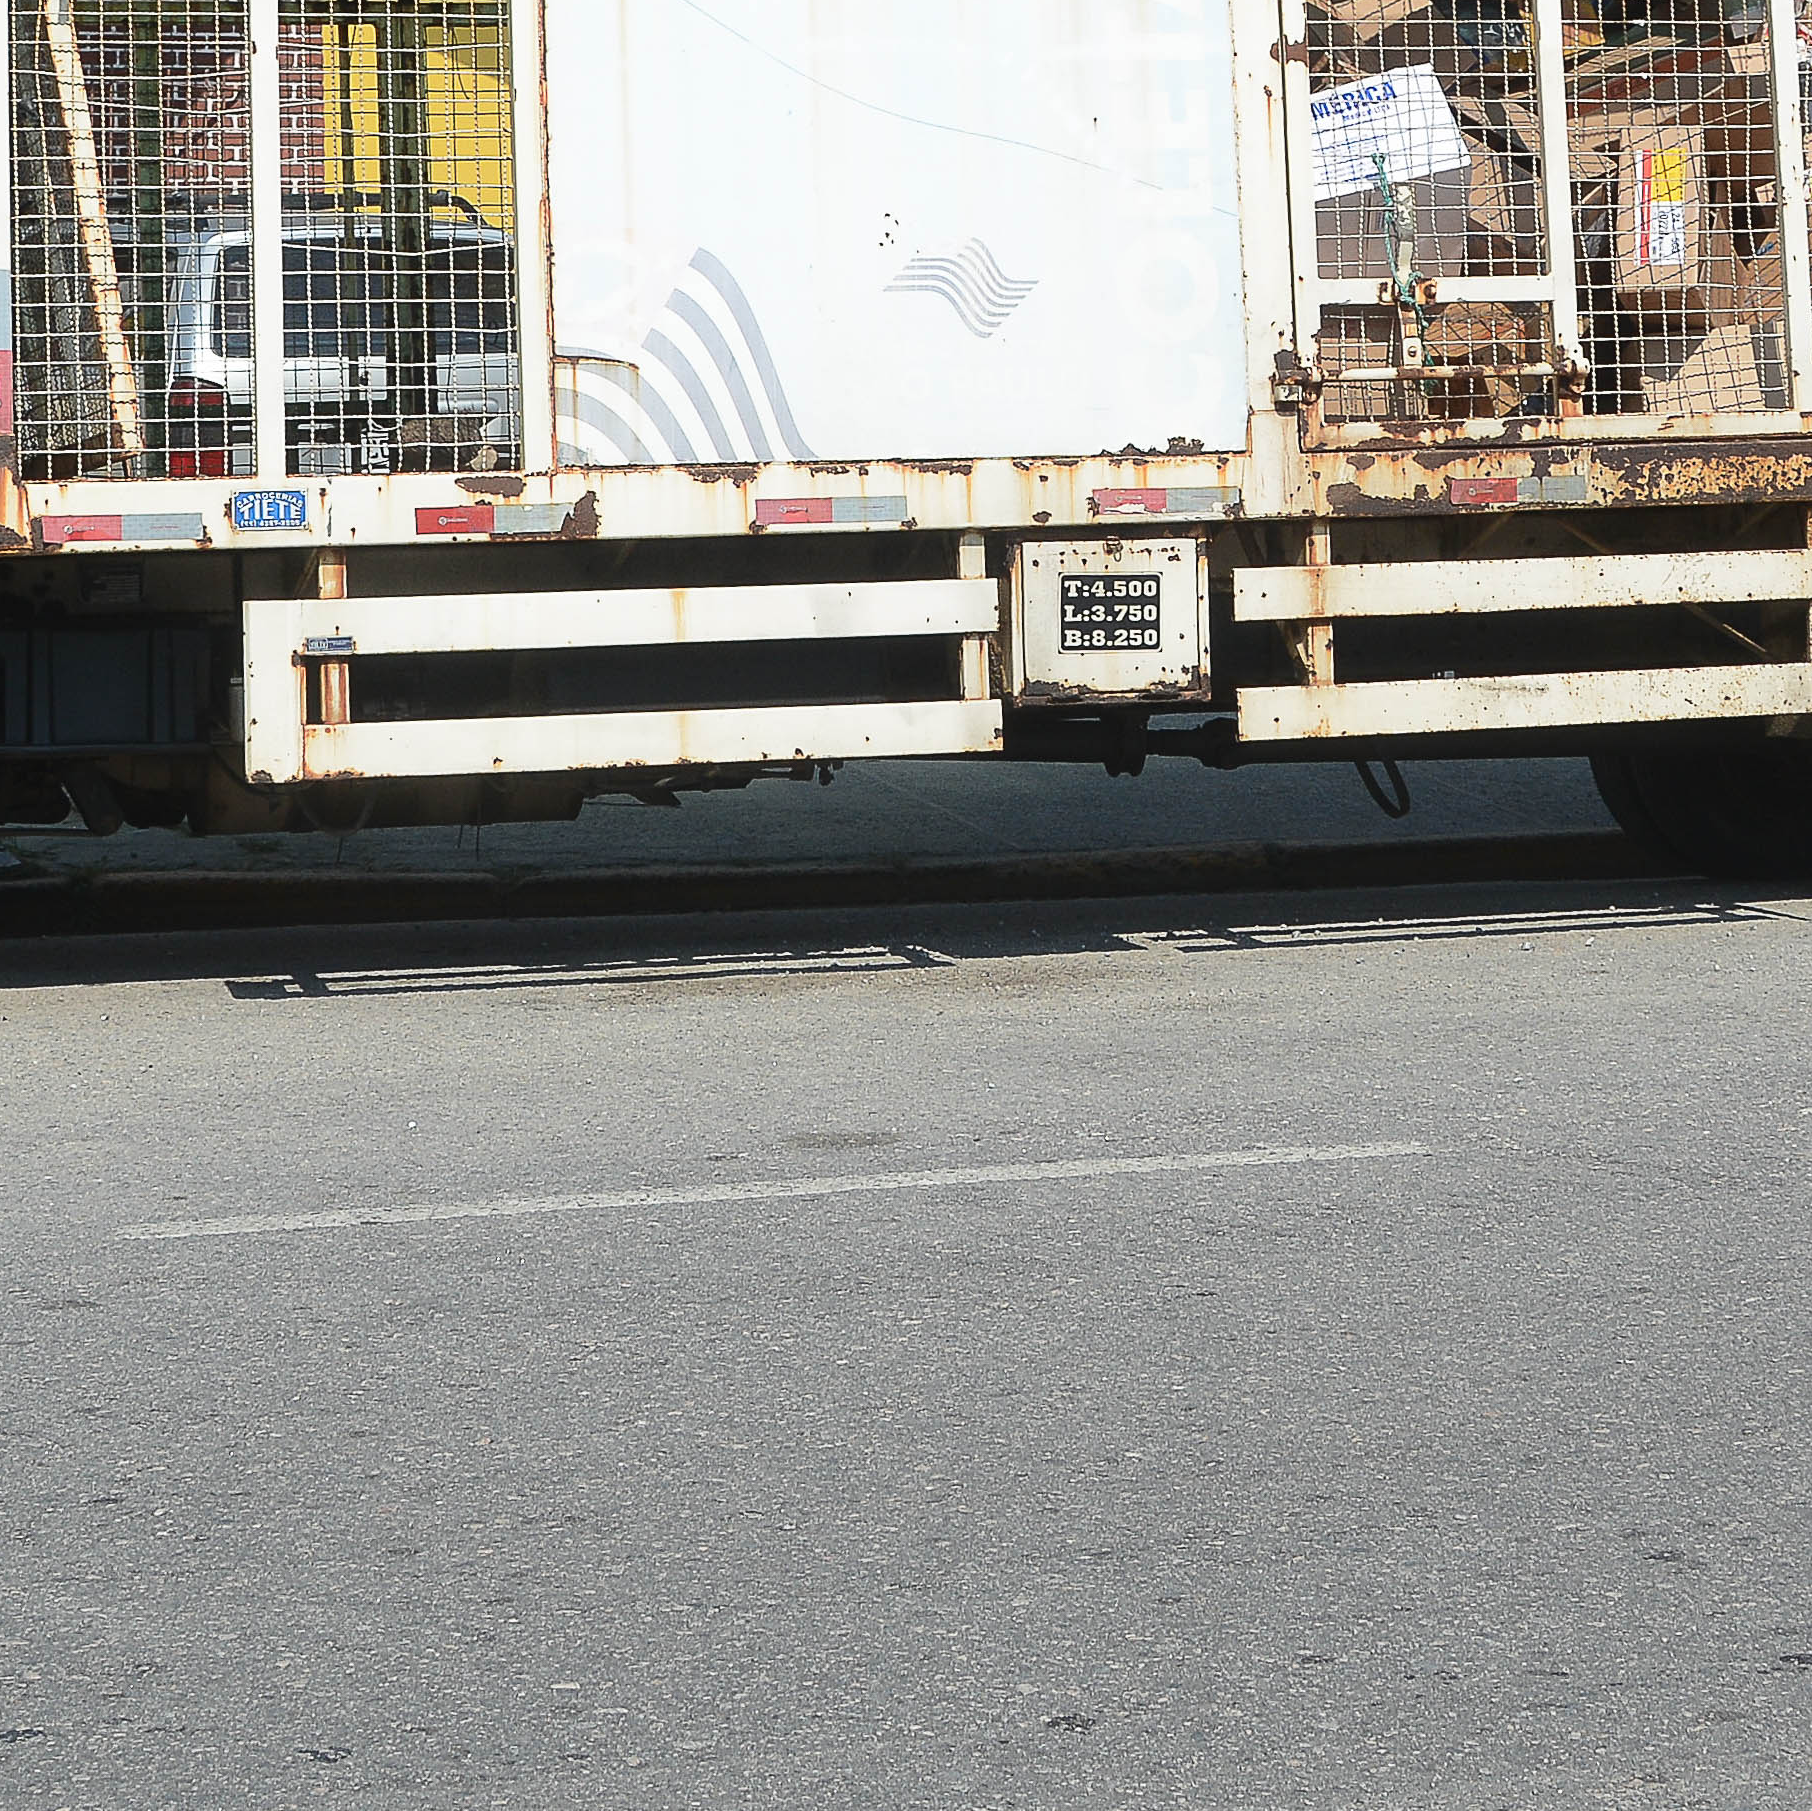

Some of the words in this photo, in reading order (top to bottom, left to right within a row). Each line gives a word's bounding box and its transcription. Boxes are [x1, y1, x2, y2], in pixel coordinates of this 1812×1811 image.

[1063, 580, 1158, 598] T:4.500
[1063, 604, 1158, 623] L:3.750
[1063, 628, 1159, 647] B:8.250
